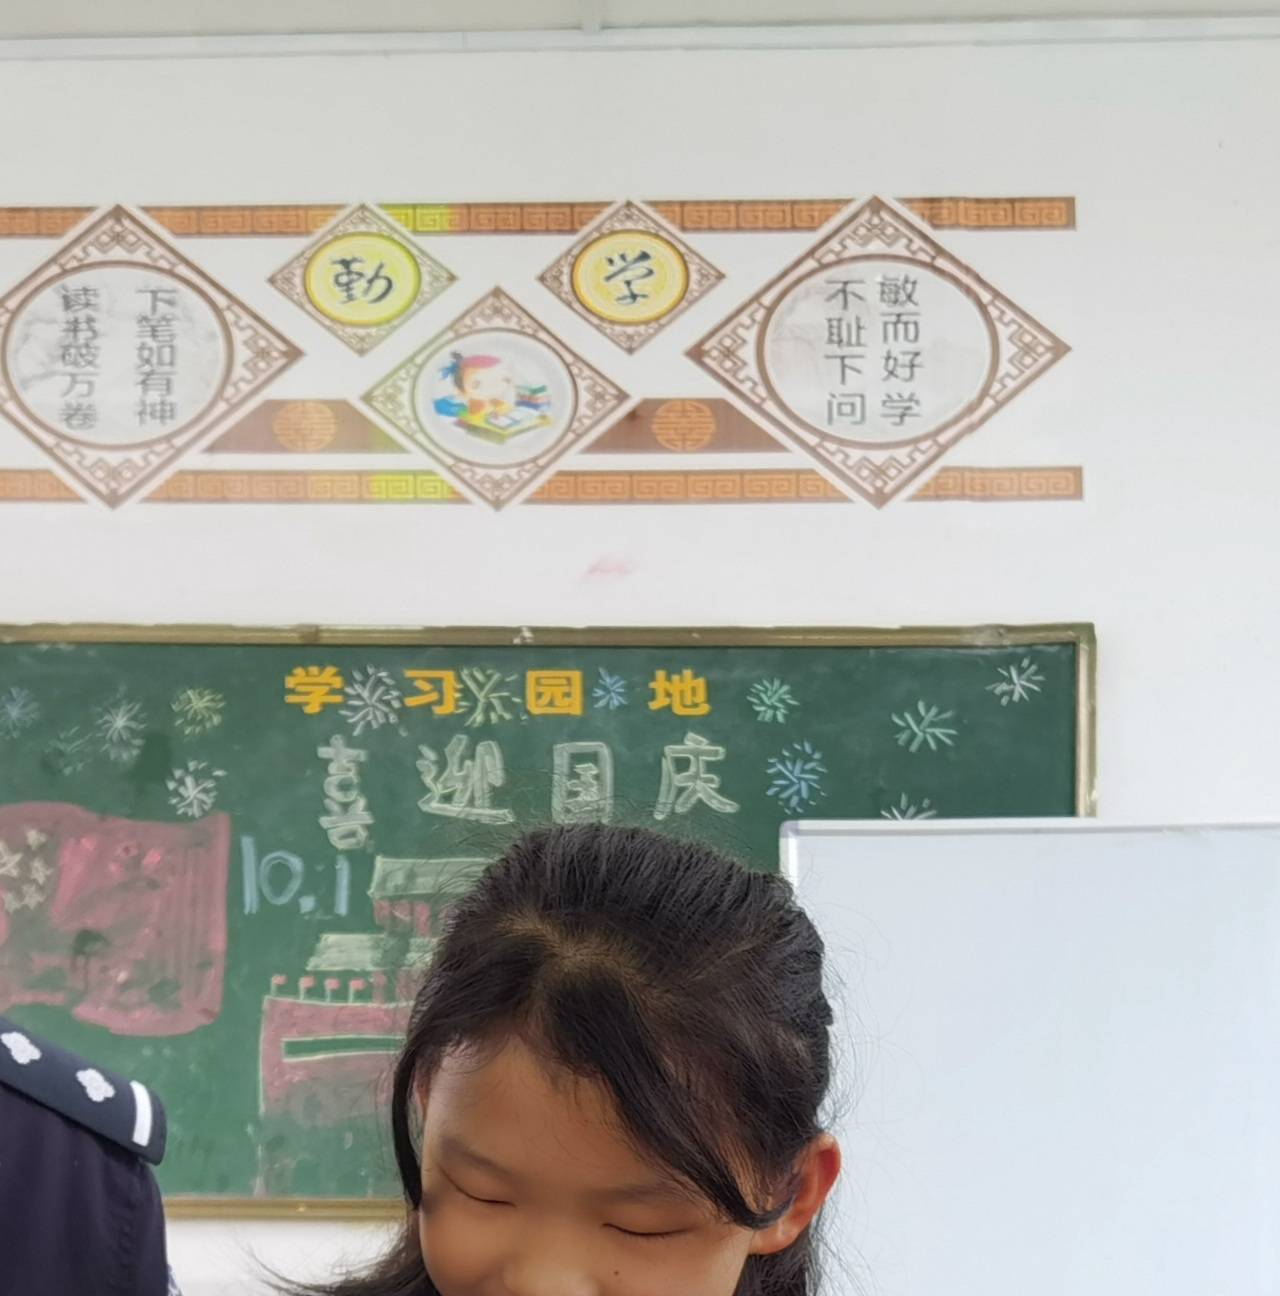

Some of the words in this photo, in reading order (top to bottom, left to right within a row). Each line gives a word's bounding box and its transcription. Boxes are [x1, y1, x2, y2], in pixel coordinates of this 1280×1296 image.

[330, 256, 394, 305] 勤
[604, 250, 654, 306] 学
[58, 284, 100, 430] 读书破万卷
[135, 287, 177, 428] 下笔如有神
[823, 277, 867, 427] 不耻下问
[878, 273, 924, 427] 敏而好学
[284, 665, 712, 716] 学习园地
[241, 836, 351, 917] 10.1
